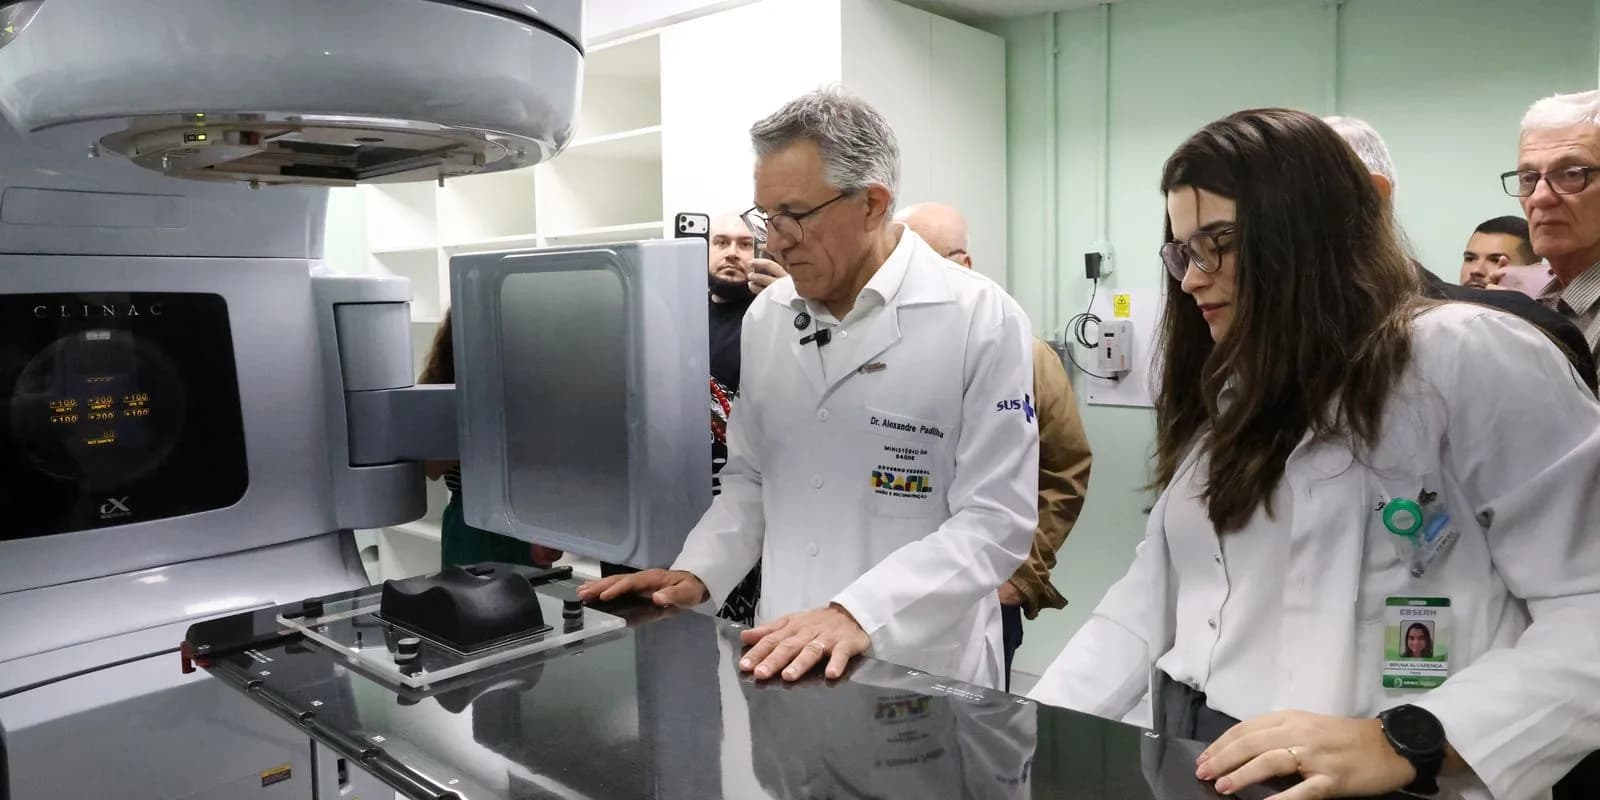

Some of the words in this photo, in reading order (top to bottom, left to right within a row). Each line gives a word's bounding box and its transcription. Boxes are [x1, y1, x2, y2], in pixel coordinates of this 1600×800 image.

[33, 304, 163, 319] CLINAC
[997, 399, 1021, 412] SUS
[870, 416, 880, 427] Dr.
[881, 418, 917, 433] Alexandre
[919, 425, 944, 438] Padilha
[884, 445, 919, 455] MINISTÉRIO
